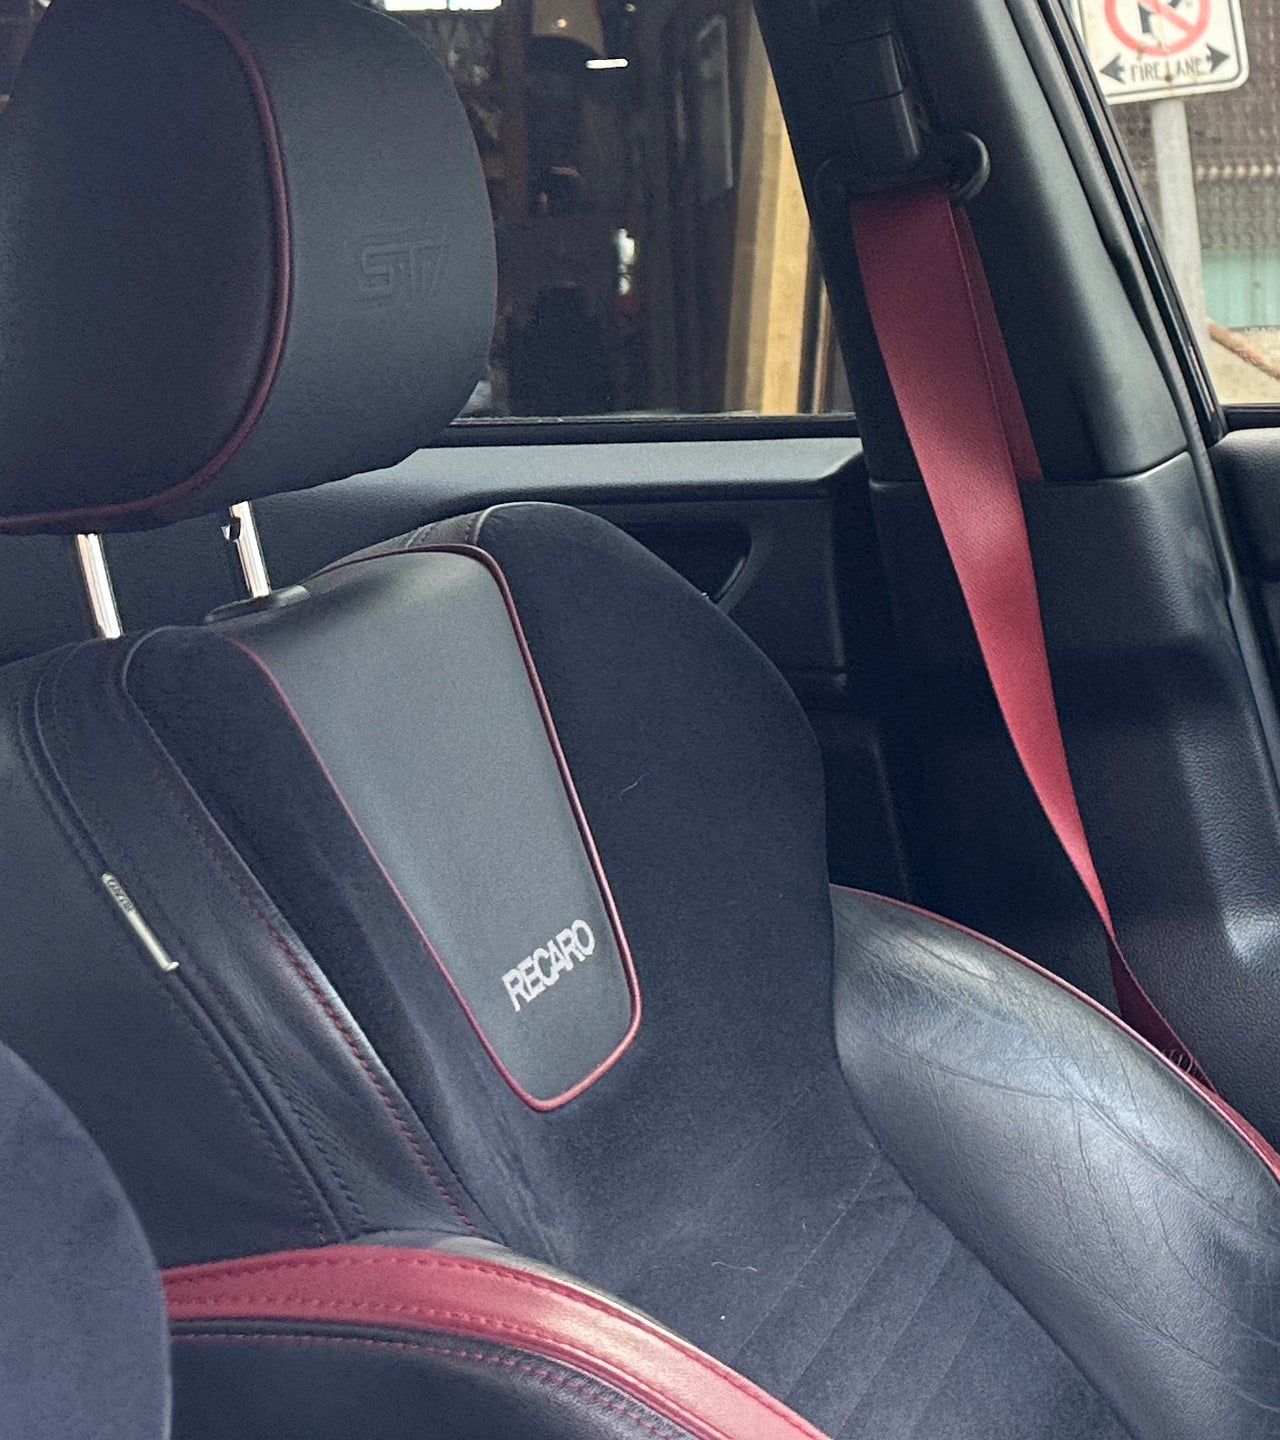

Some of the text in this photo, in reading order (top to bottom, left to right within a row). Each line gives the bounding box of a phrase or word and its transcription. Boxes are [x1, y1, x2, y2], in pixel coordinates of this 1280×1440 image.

[1131, 55, 1203, 82] FIRE LANE
[501, 919, 596, 1013] RECARO
